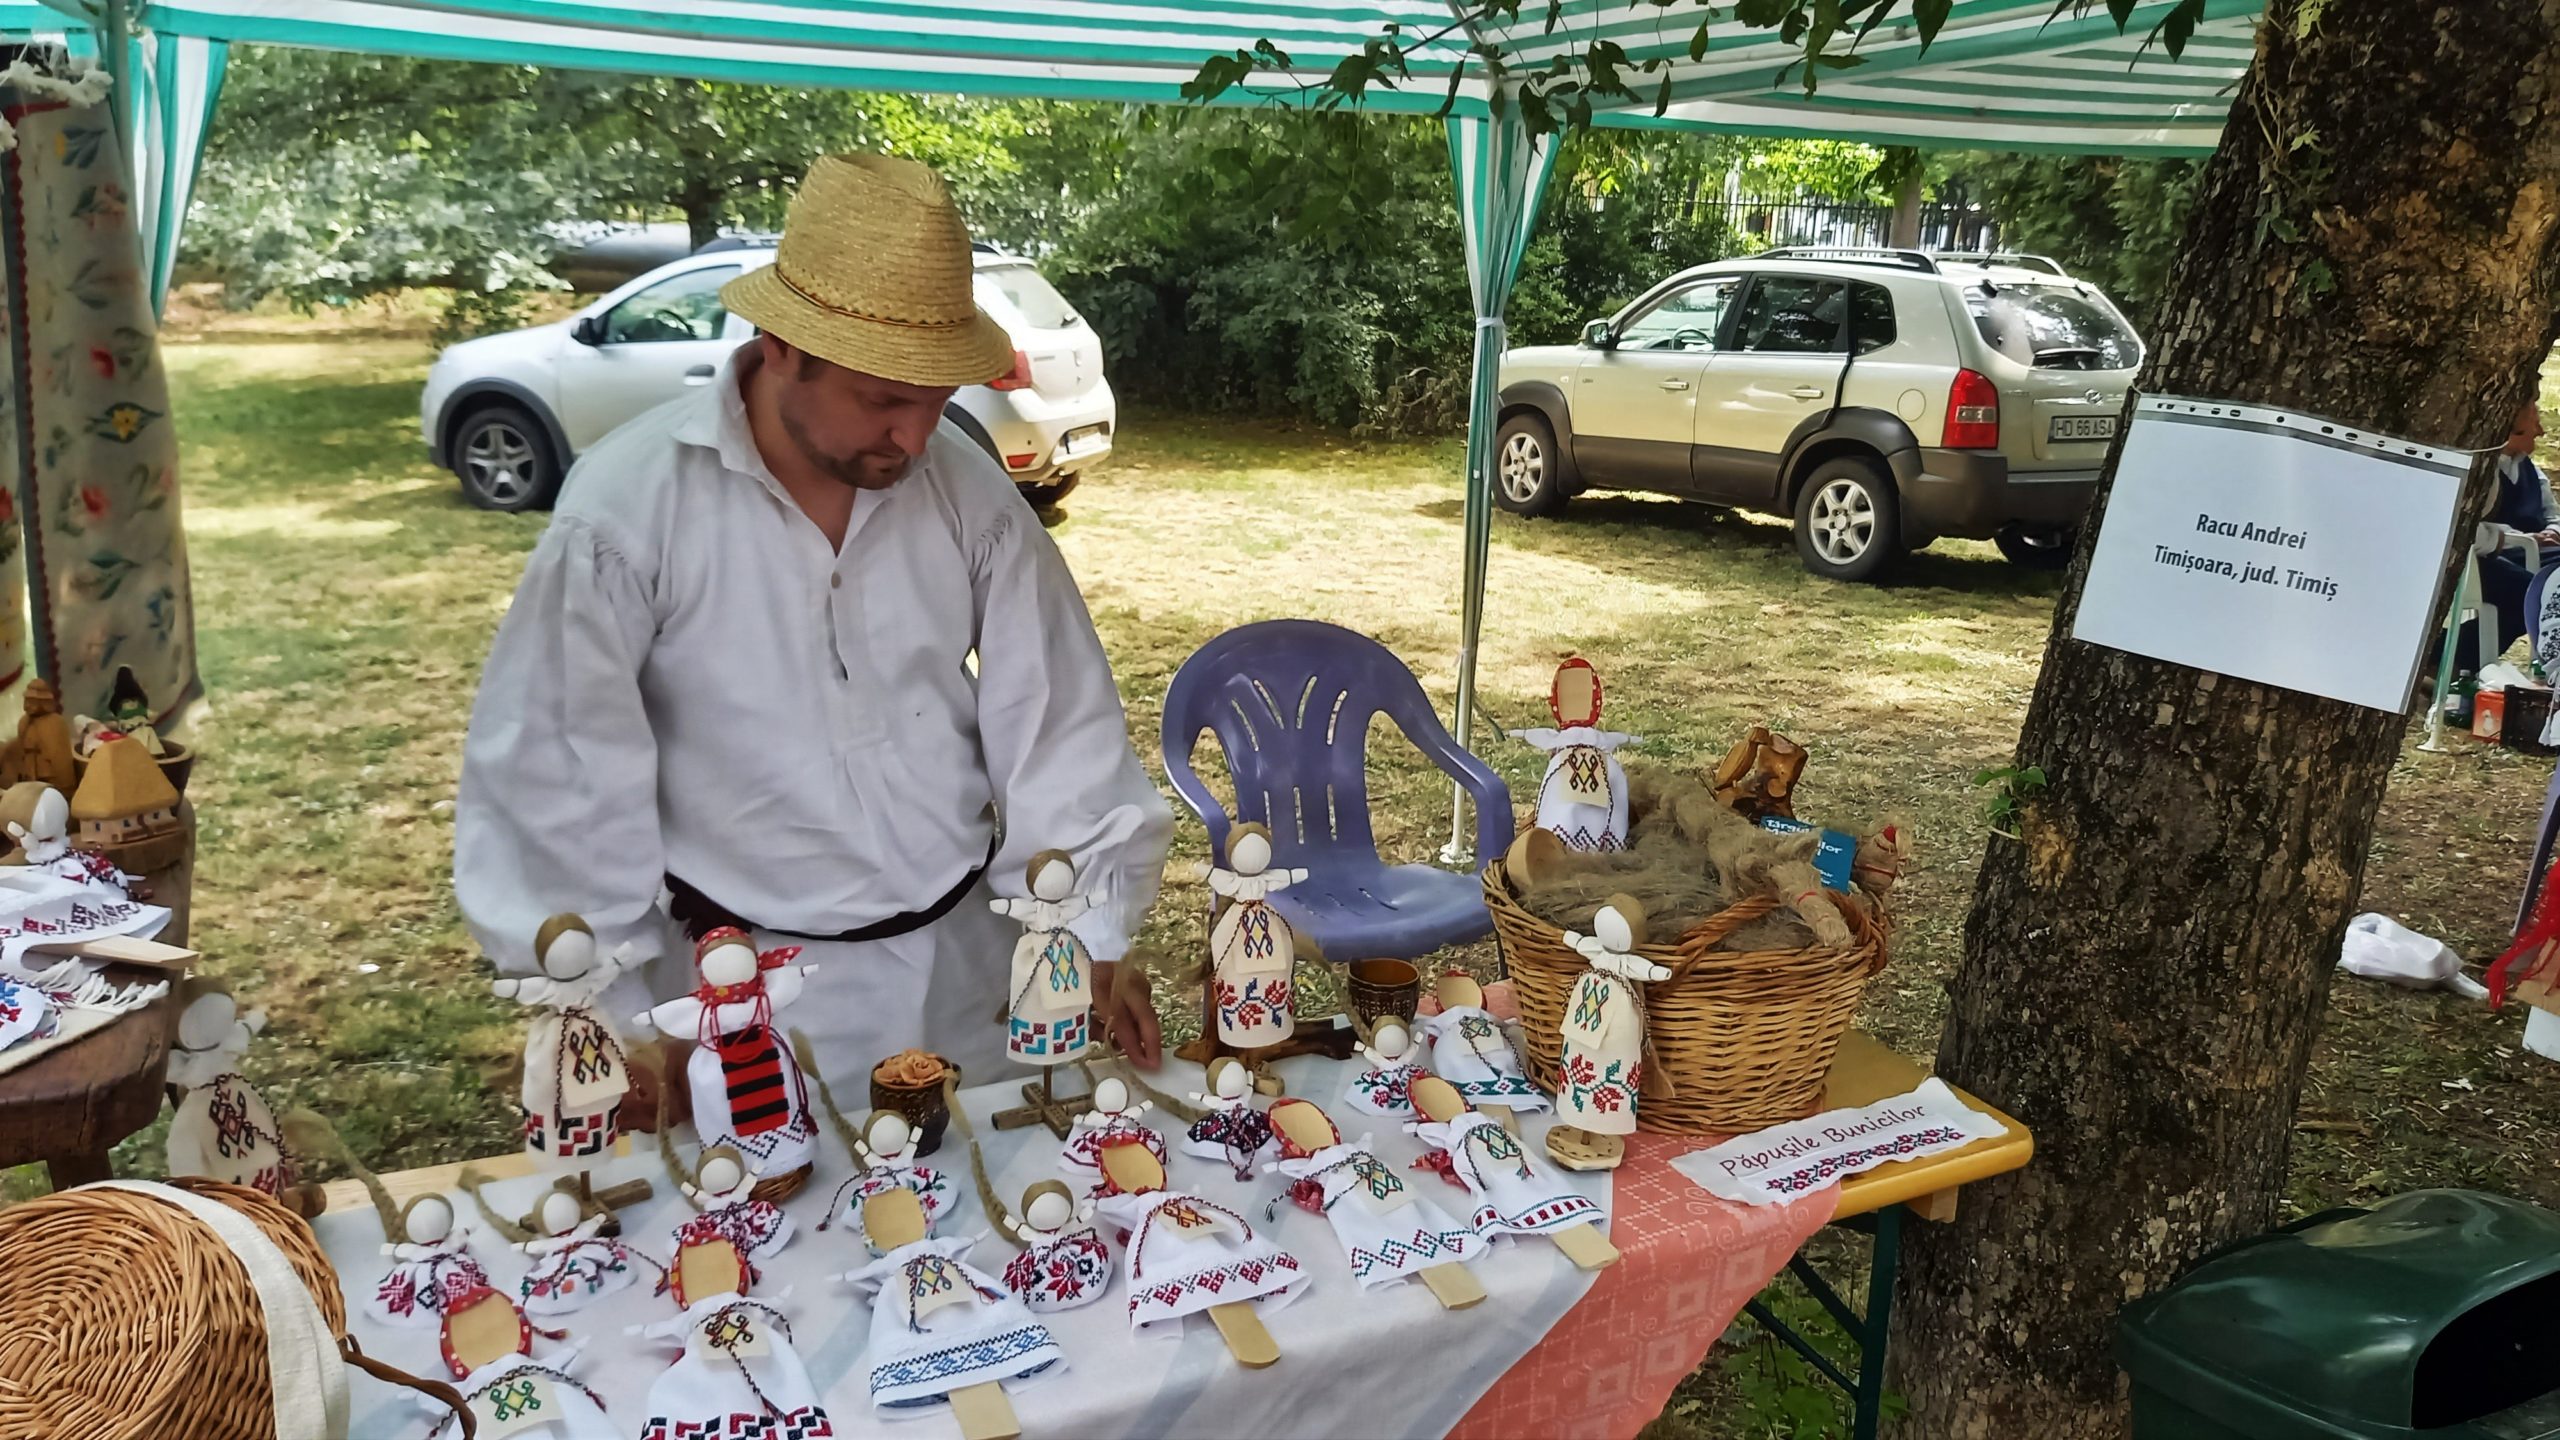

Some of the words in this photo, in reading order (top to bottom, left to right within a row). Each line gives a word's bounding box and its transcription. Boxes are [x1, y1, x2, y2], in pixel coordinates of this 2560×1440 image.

[2055, 419, 2073, 437] HD
[2077, 419, 2090, 437] 66
[2196, 513, 2239, 538] Racu
[2240, 521, 2307, 550] Andrei
[2154, 544, 2238, 580] Timișoara,
[2239, 561, 2279, 586] jud.
[2285, 568, 2339, 601] Timiș
[1719, 1135, 1821, 1177] Păpușile
[1822, 1104, 1926, 1143] Bunicilor
